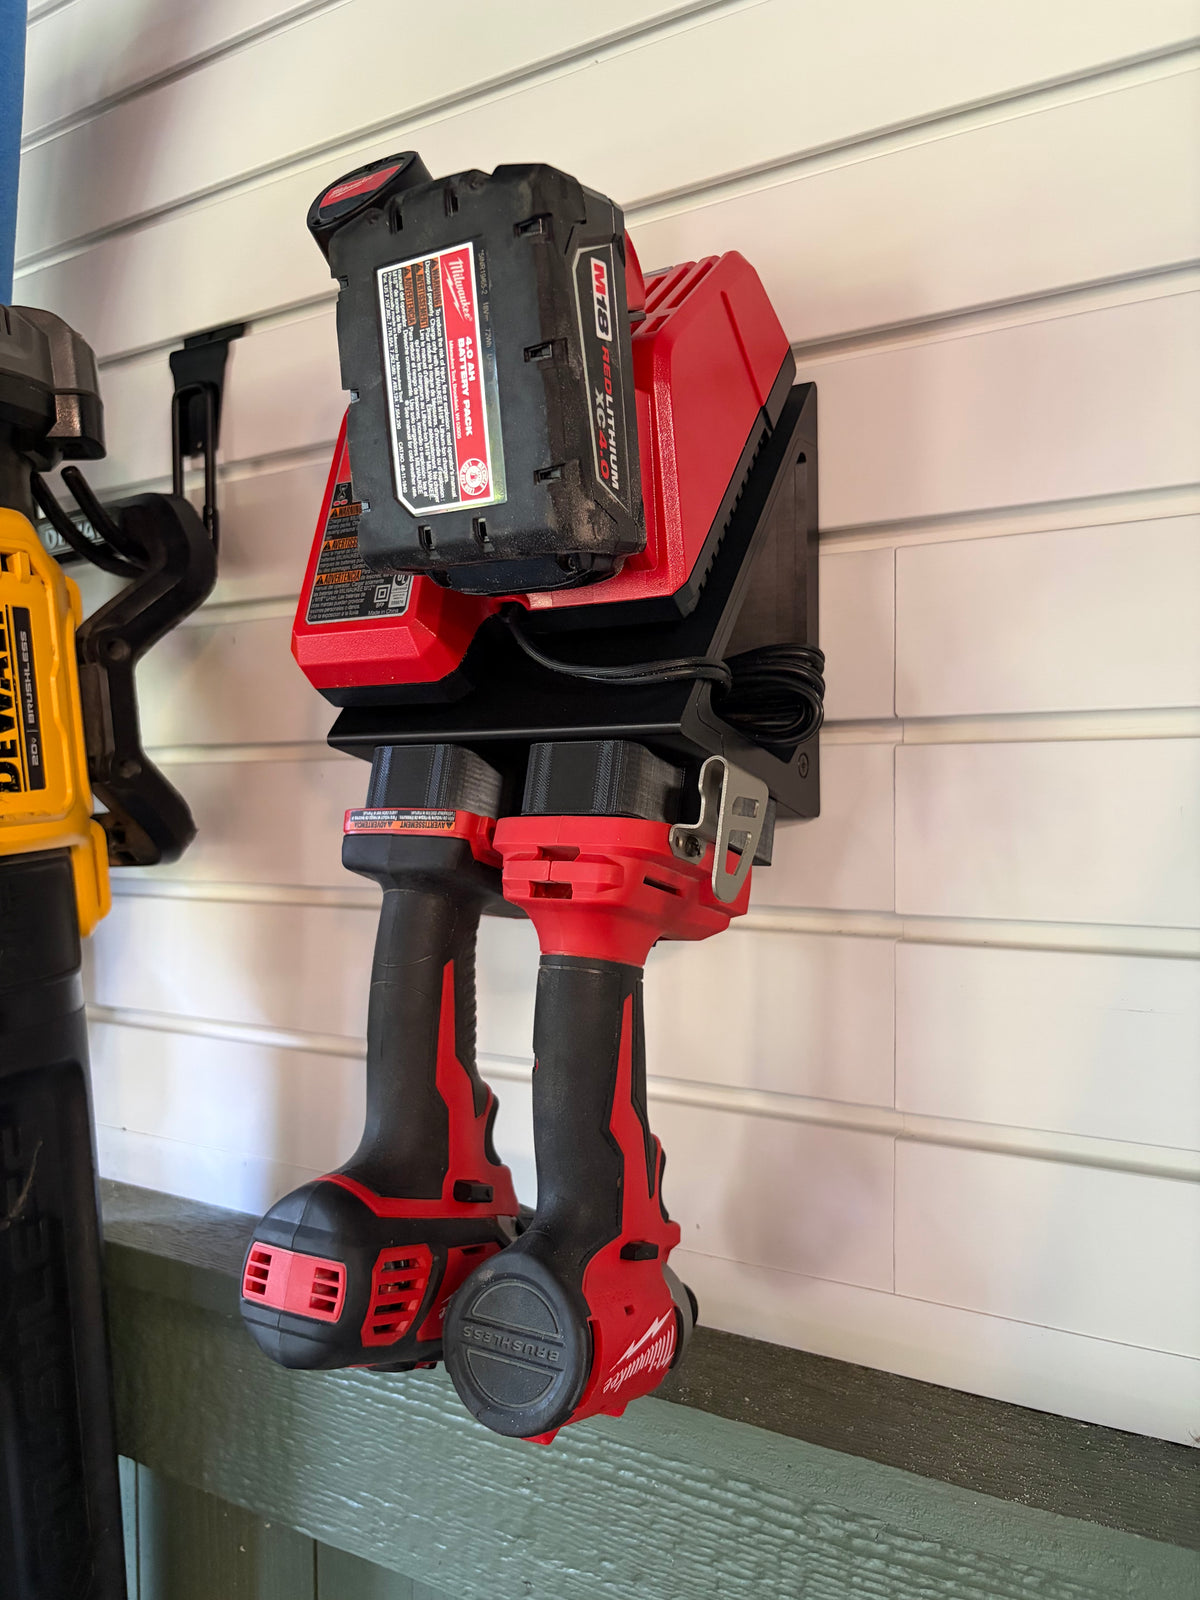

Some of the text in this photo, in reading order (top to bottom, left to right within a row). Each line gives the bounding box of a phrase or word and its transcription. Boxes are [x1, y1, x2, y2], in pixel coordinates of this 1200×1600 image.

[449, 257, 471, 320] Milwaukee
[594, 263, 609, 336] M18
[457, 337, 472, 436] BATTERY PACK
[465, 335, 475, 381] 4.0 AH
[602, 345, 619, 490] REDLITHIUM
[20, 630, 36, 724] BRUSHLESS
[463, 1326, 559, 1361] BRUSHLESS
[603, 1324, 675, 1394] Milwaukee
